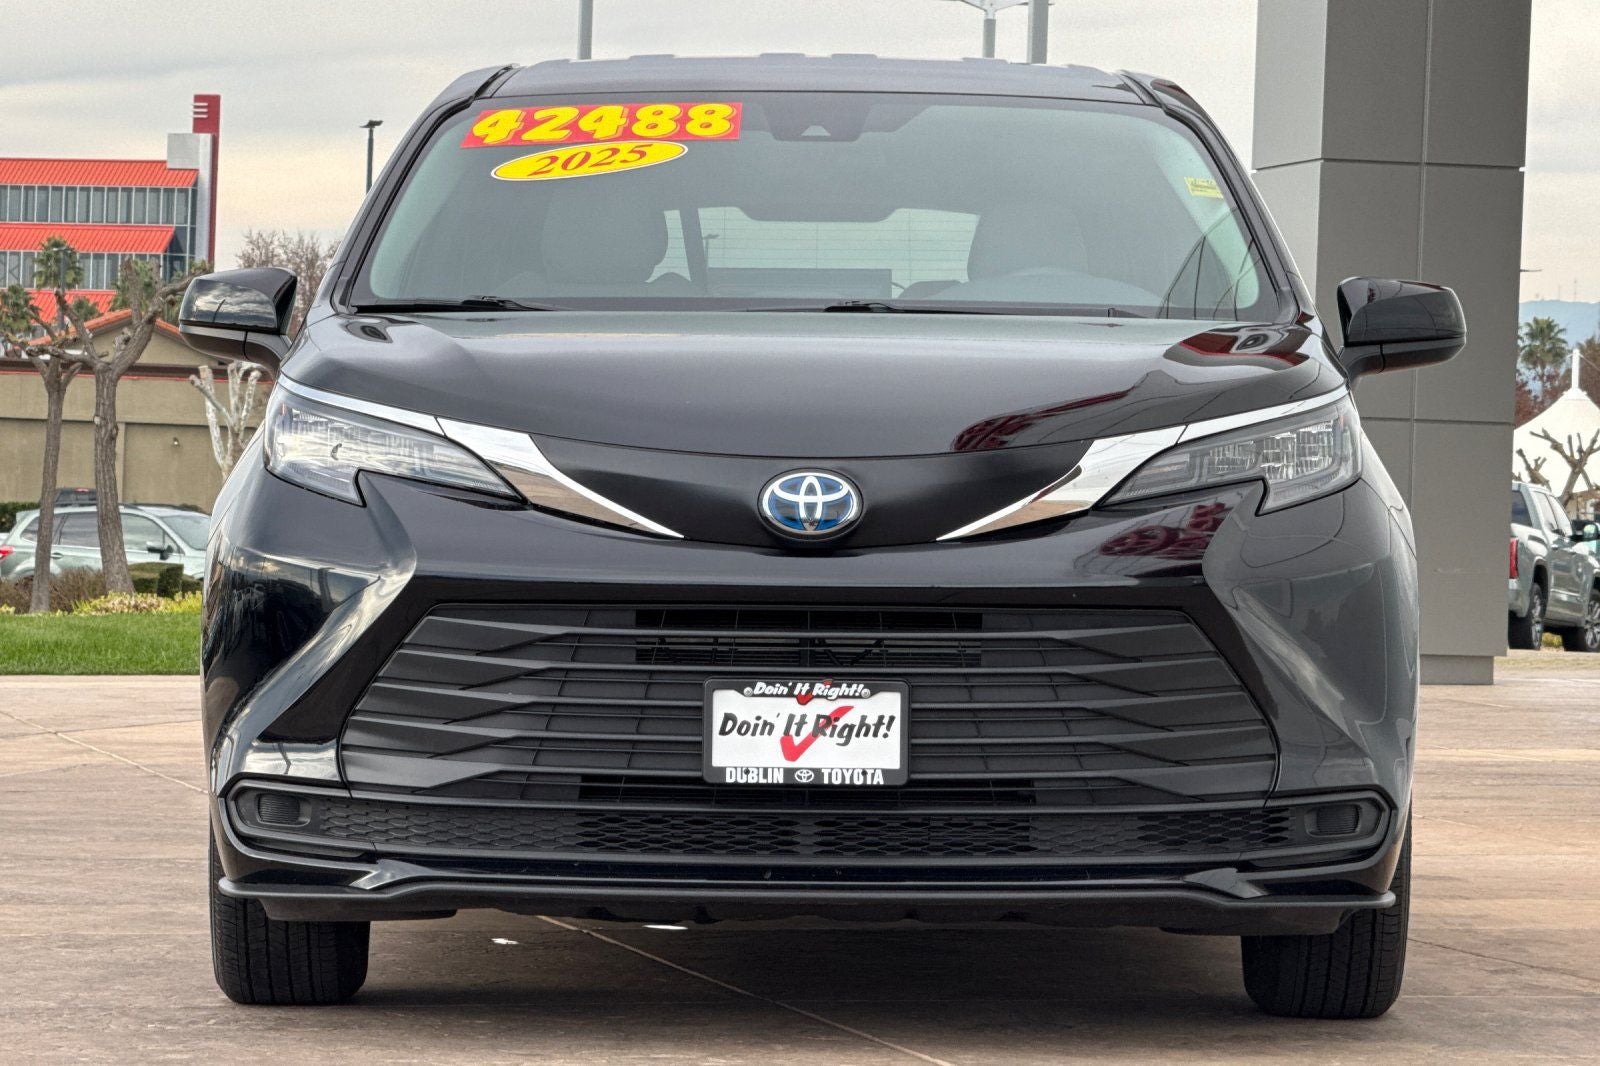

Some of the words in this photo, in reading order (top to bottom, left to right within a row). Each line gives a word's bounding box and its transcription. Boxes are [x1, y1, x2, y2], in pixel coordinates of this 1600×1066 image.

[473, 103, 735, 144] 42488
[528, 144, 654, 177] 2025
[753, 682, 793, 696] Doin'
[794, 682, 809, 696] It
[812, 683, 865, 700] Right!
[718, 712, 781, 737] Doin'
[783, 713, 808, 738] It
[811, 713, 896, 747] Right!
[725, 767, 784, 784] DUBLIN
[822, 768, 885, 785] TOYOTA
